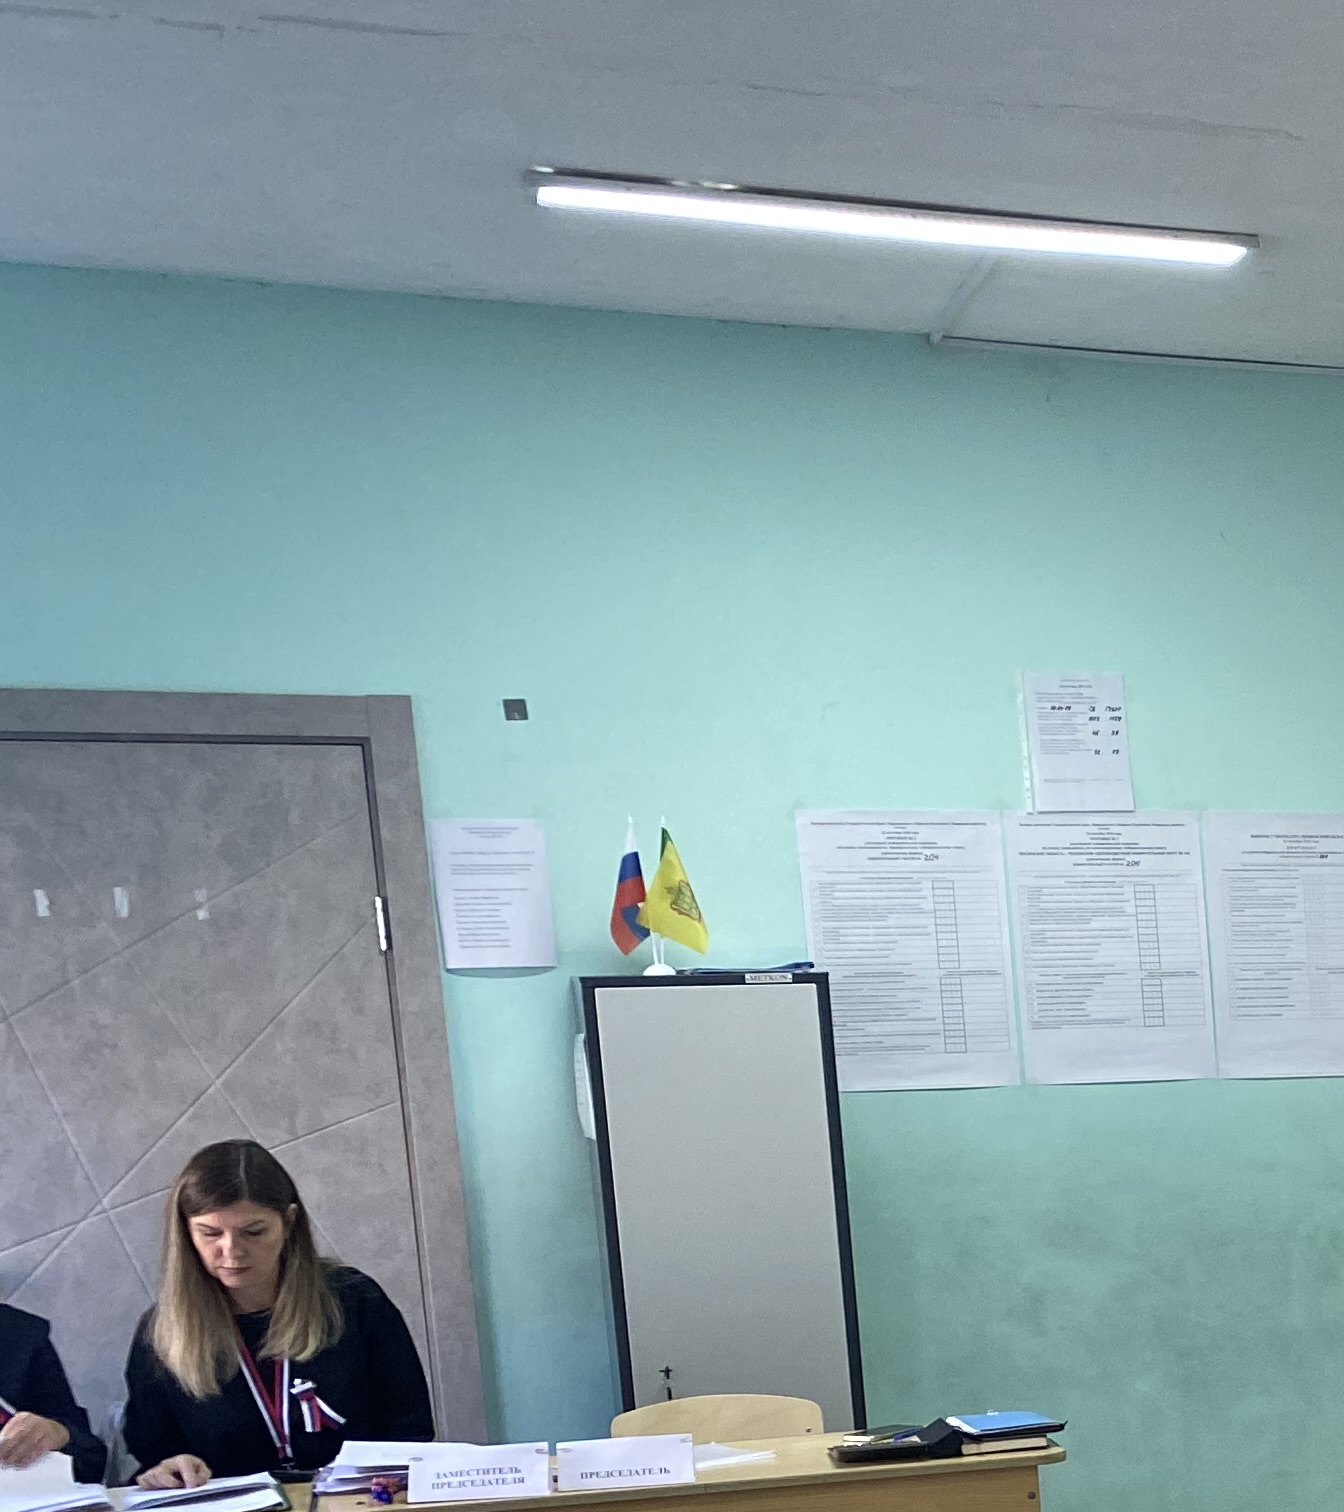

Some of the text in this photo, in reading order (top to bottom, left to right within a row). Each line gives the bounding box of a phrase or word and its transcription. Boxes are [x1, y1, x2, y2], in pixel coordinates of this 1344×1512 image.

[434, 1466, 522, 1480] ЗАМЕСТИТЕЛЬ
[580, 1466, 671, 1480] ПРЕДСЕДАТЕЛЬ
[431, 1476, 525, 1490] ПРЕДСЕДАТЕЛЯ
